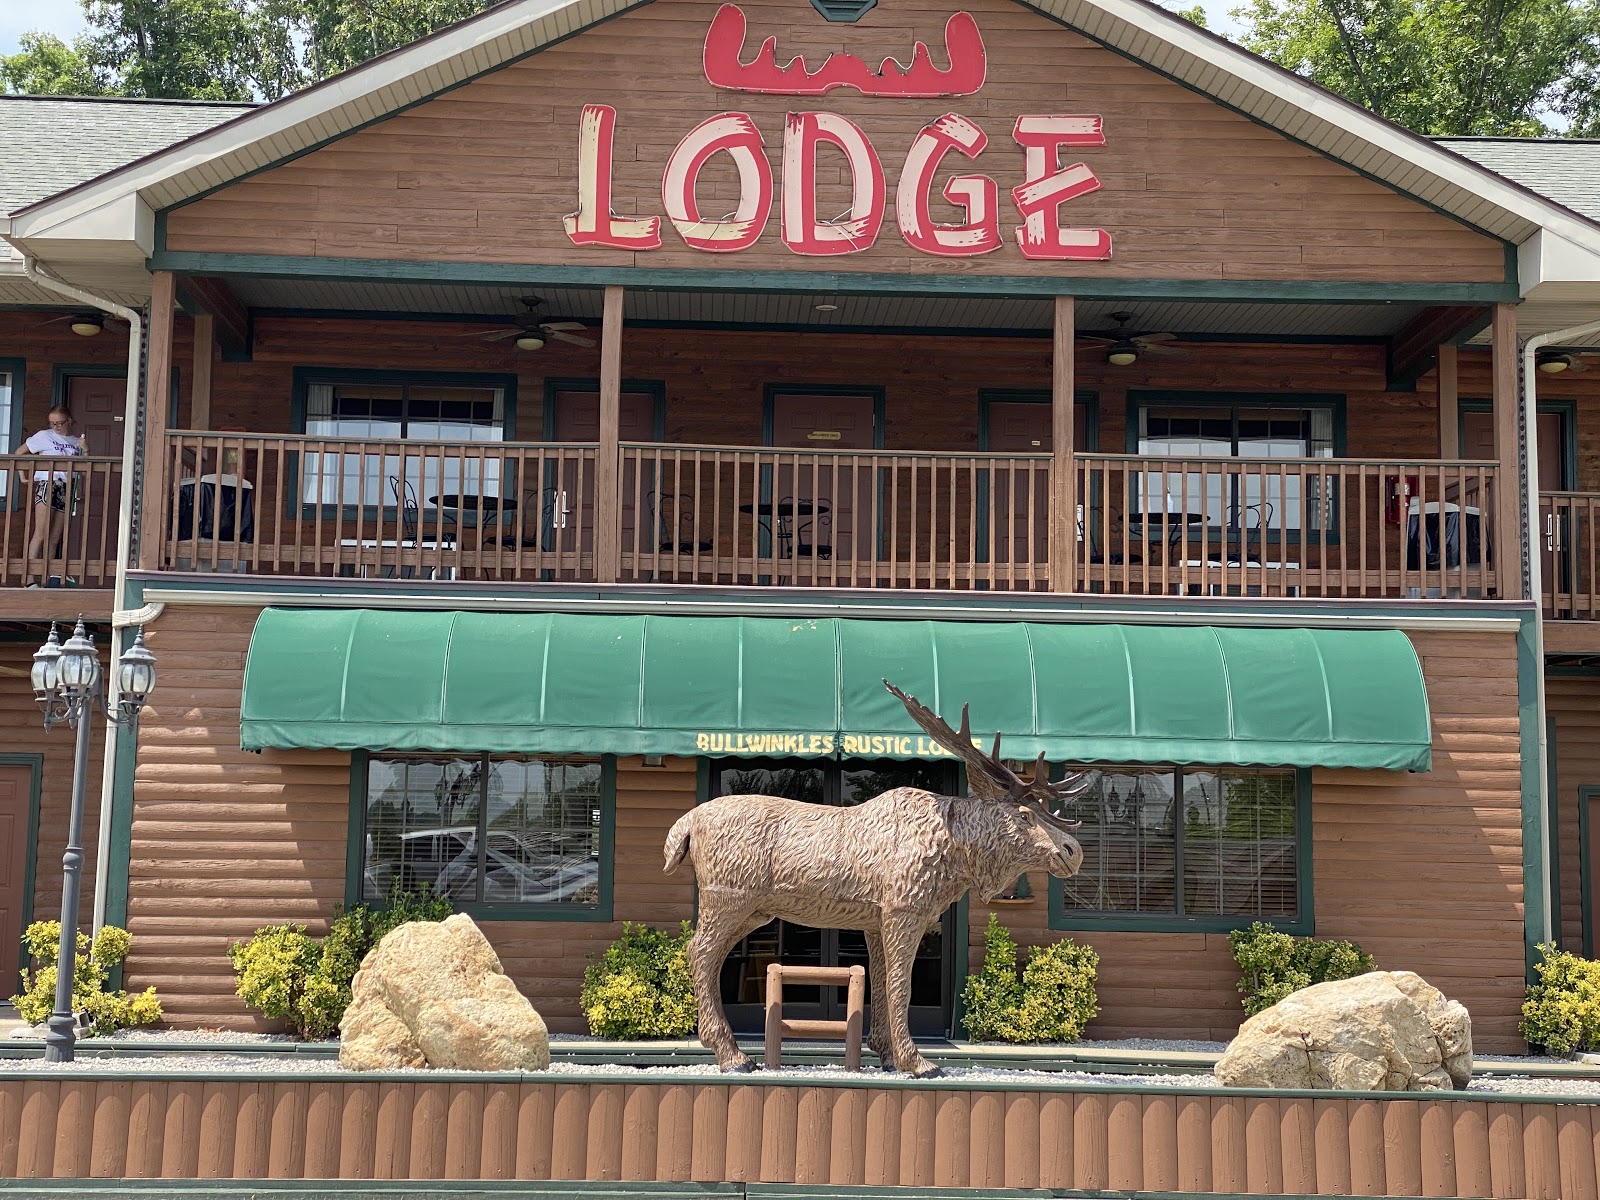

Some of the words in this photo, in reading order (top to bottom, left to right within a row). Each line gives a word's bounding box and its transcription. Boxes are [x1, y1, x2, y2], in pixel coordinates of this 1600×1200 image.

[563, 103, 1113, 260] LODGE
[696, 732, 835, 754] BULLWINKLES
[843, 734, 913, 755] RUSTIC
